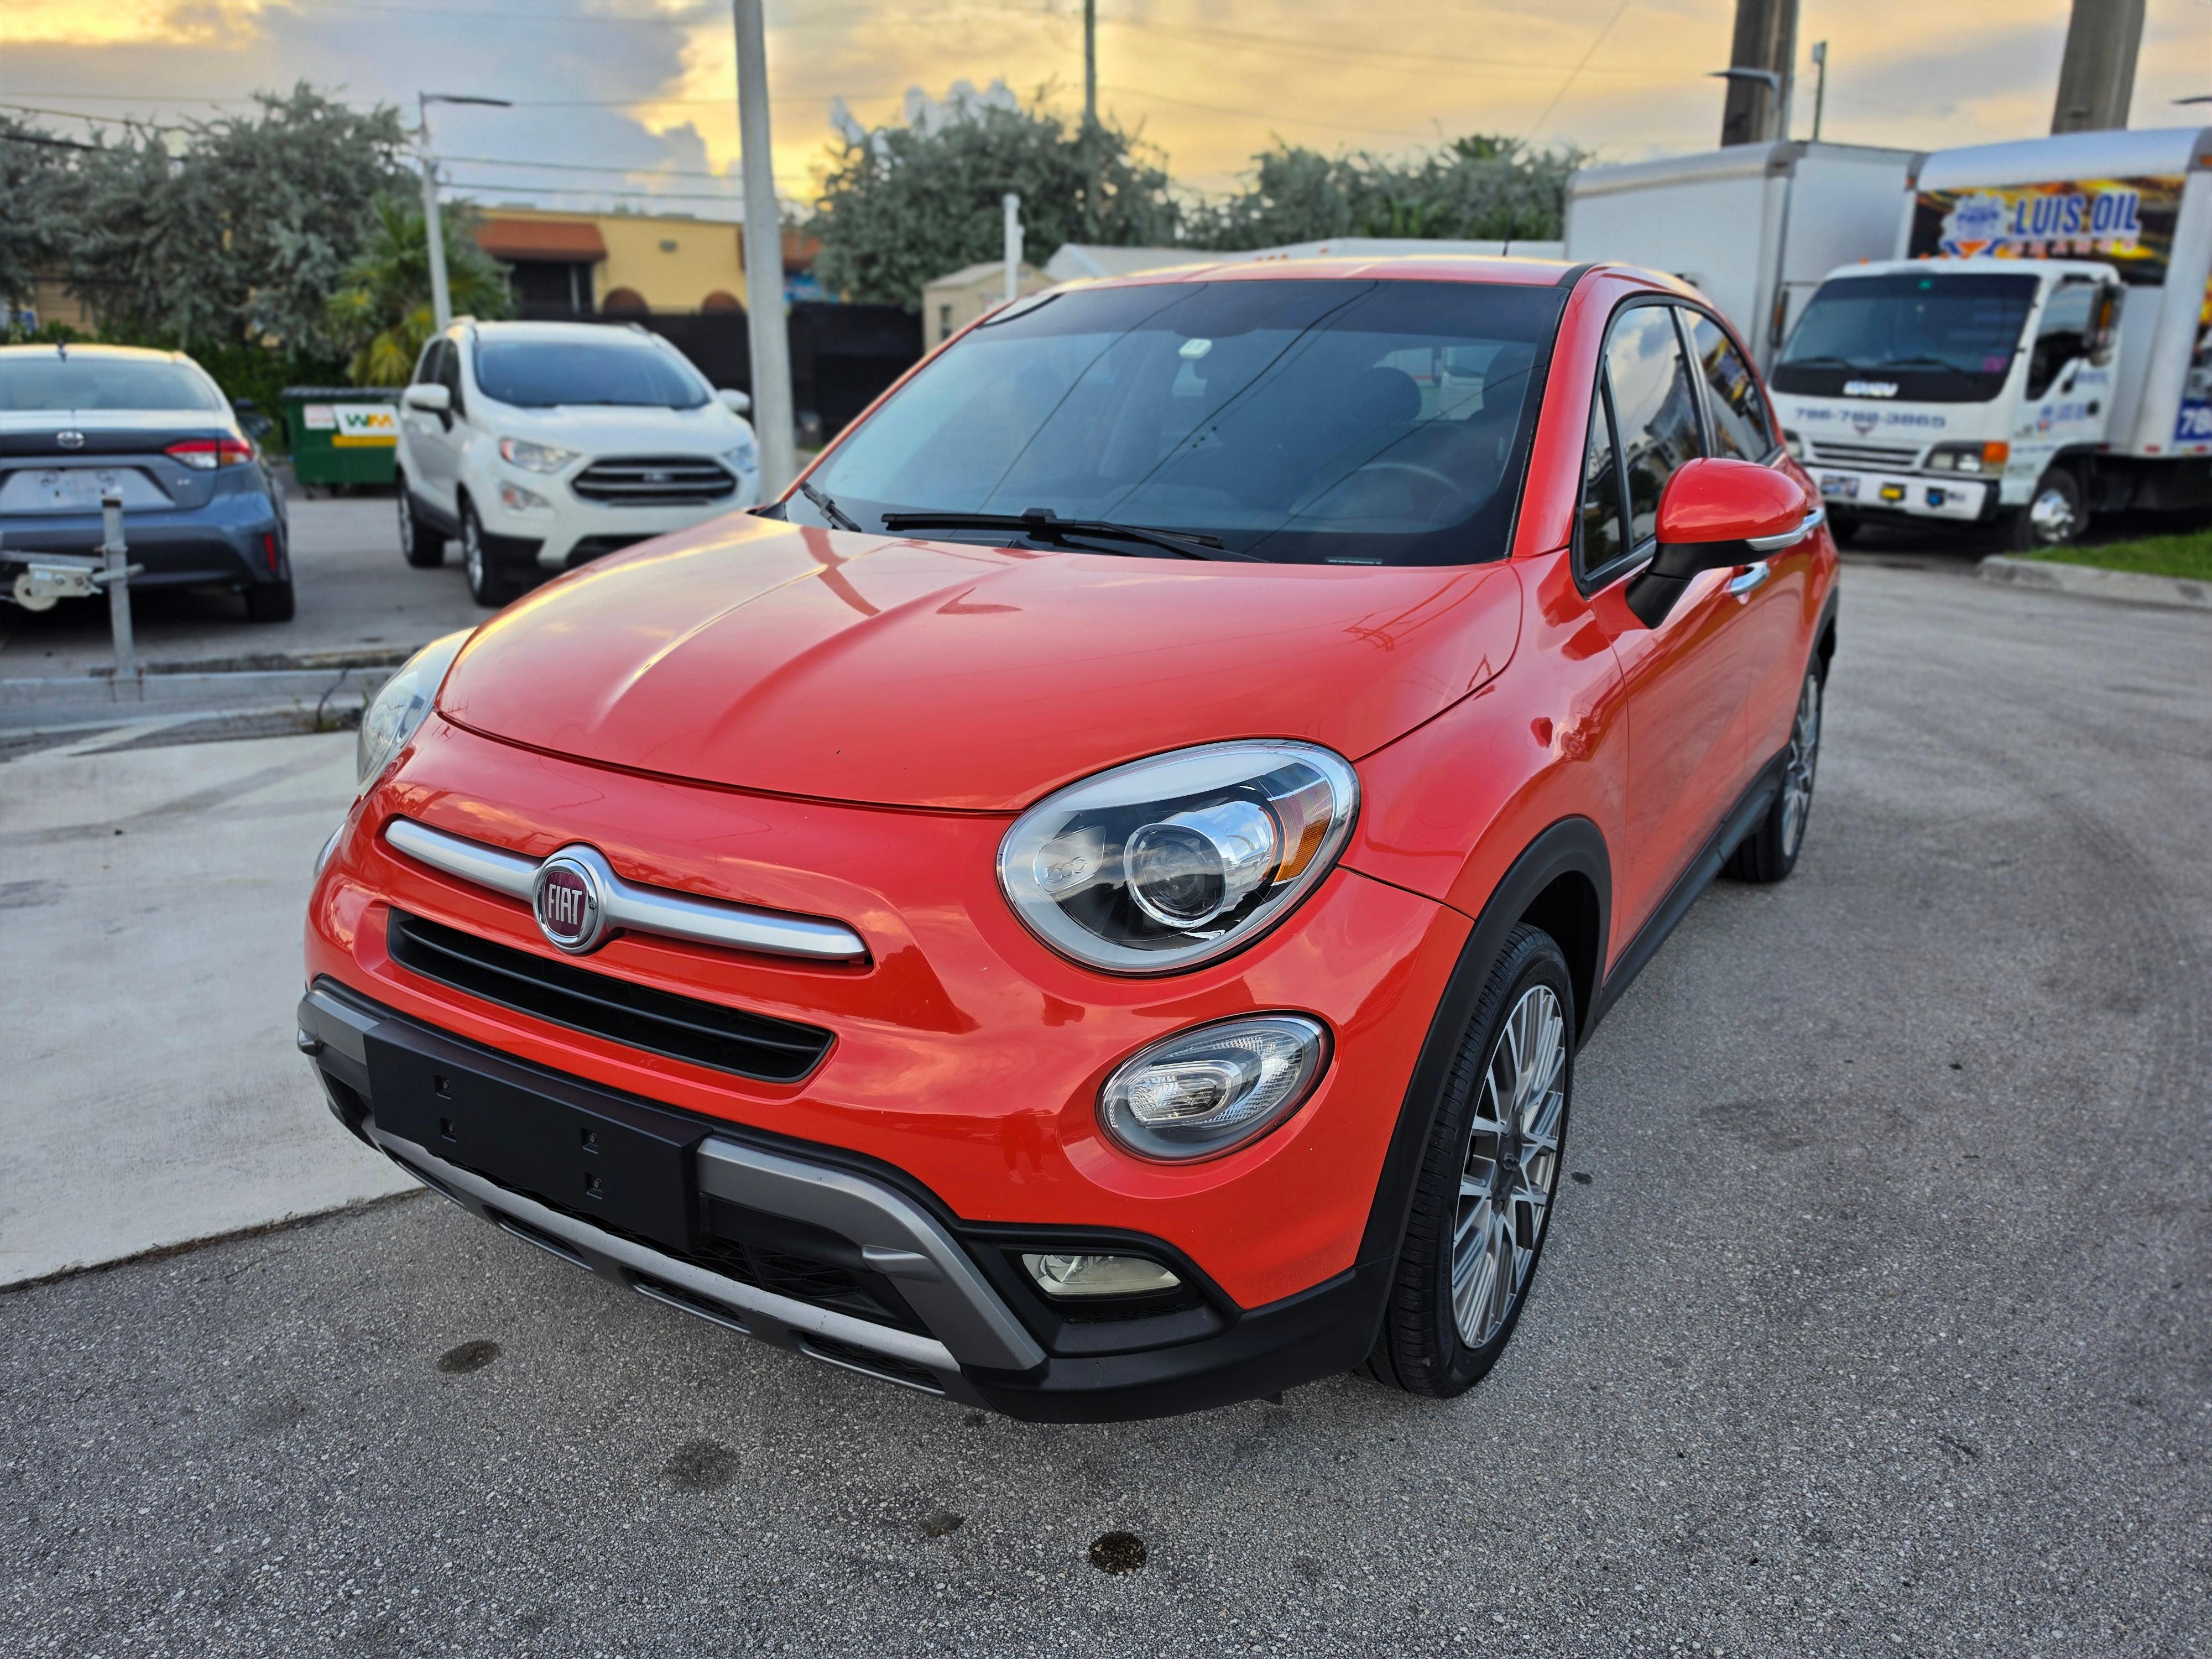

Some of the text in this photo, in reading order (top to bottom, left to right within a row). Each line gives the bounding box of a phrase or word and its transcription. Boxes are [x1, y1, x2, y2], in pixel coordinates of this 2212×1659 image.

[2014, 195, 2085, 236] LUIS
[2091, 192, 2138, 232] OIL
[345, 413, 394, 428] WM
[548, 883, 583, 925] FIAT
